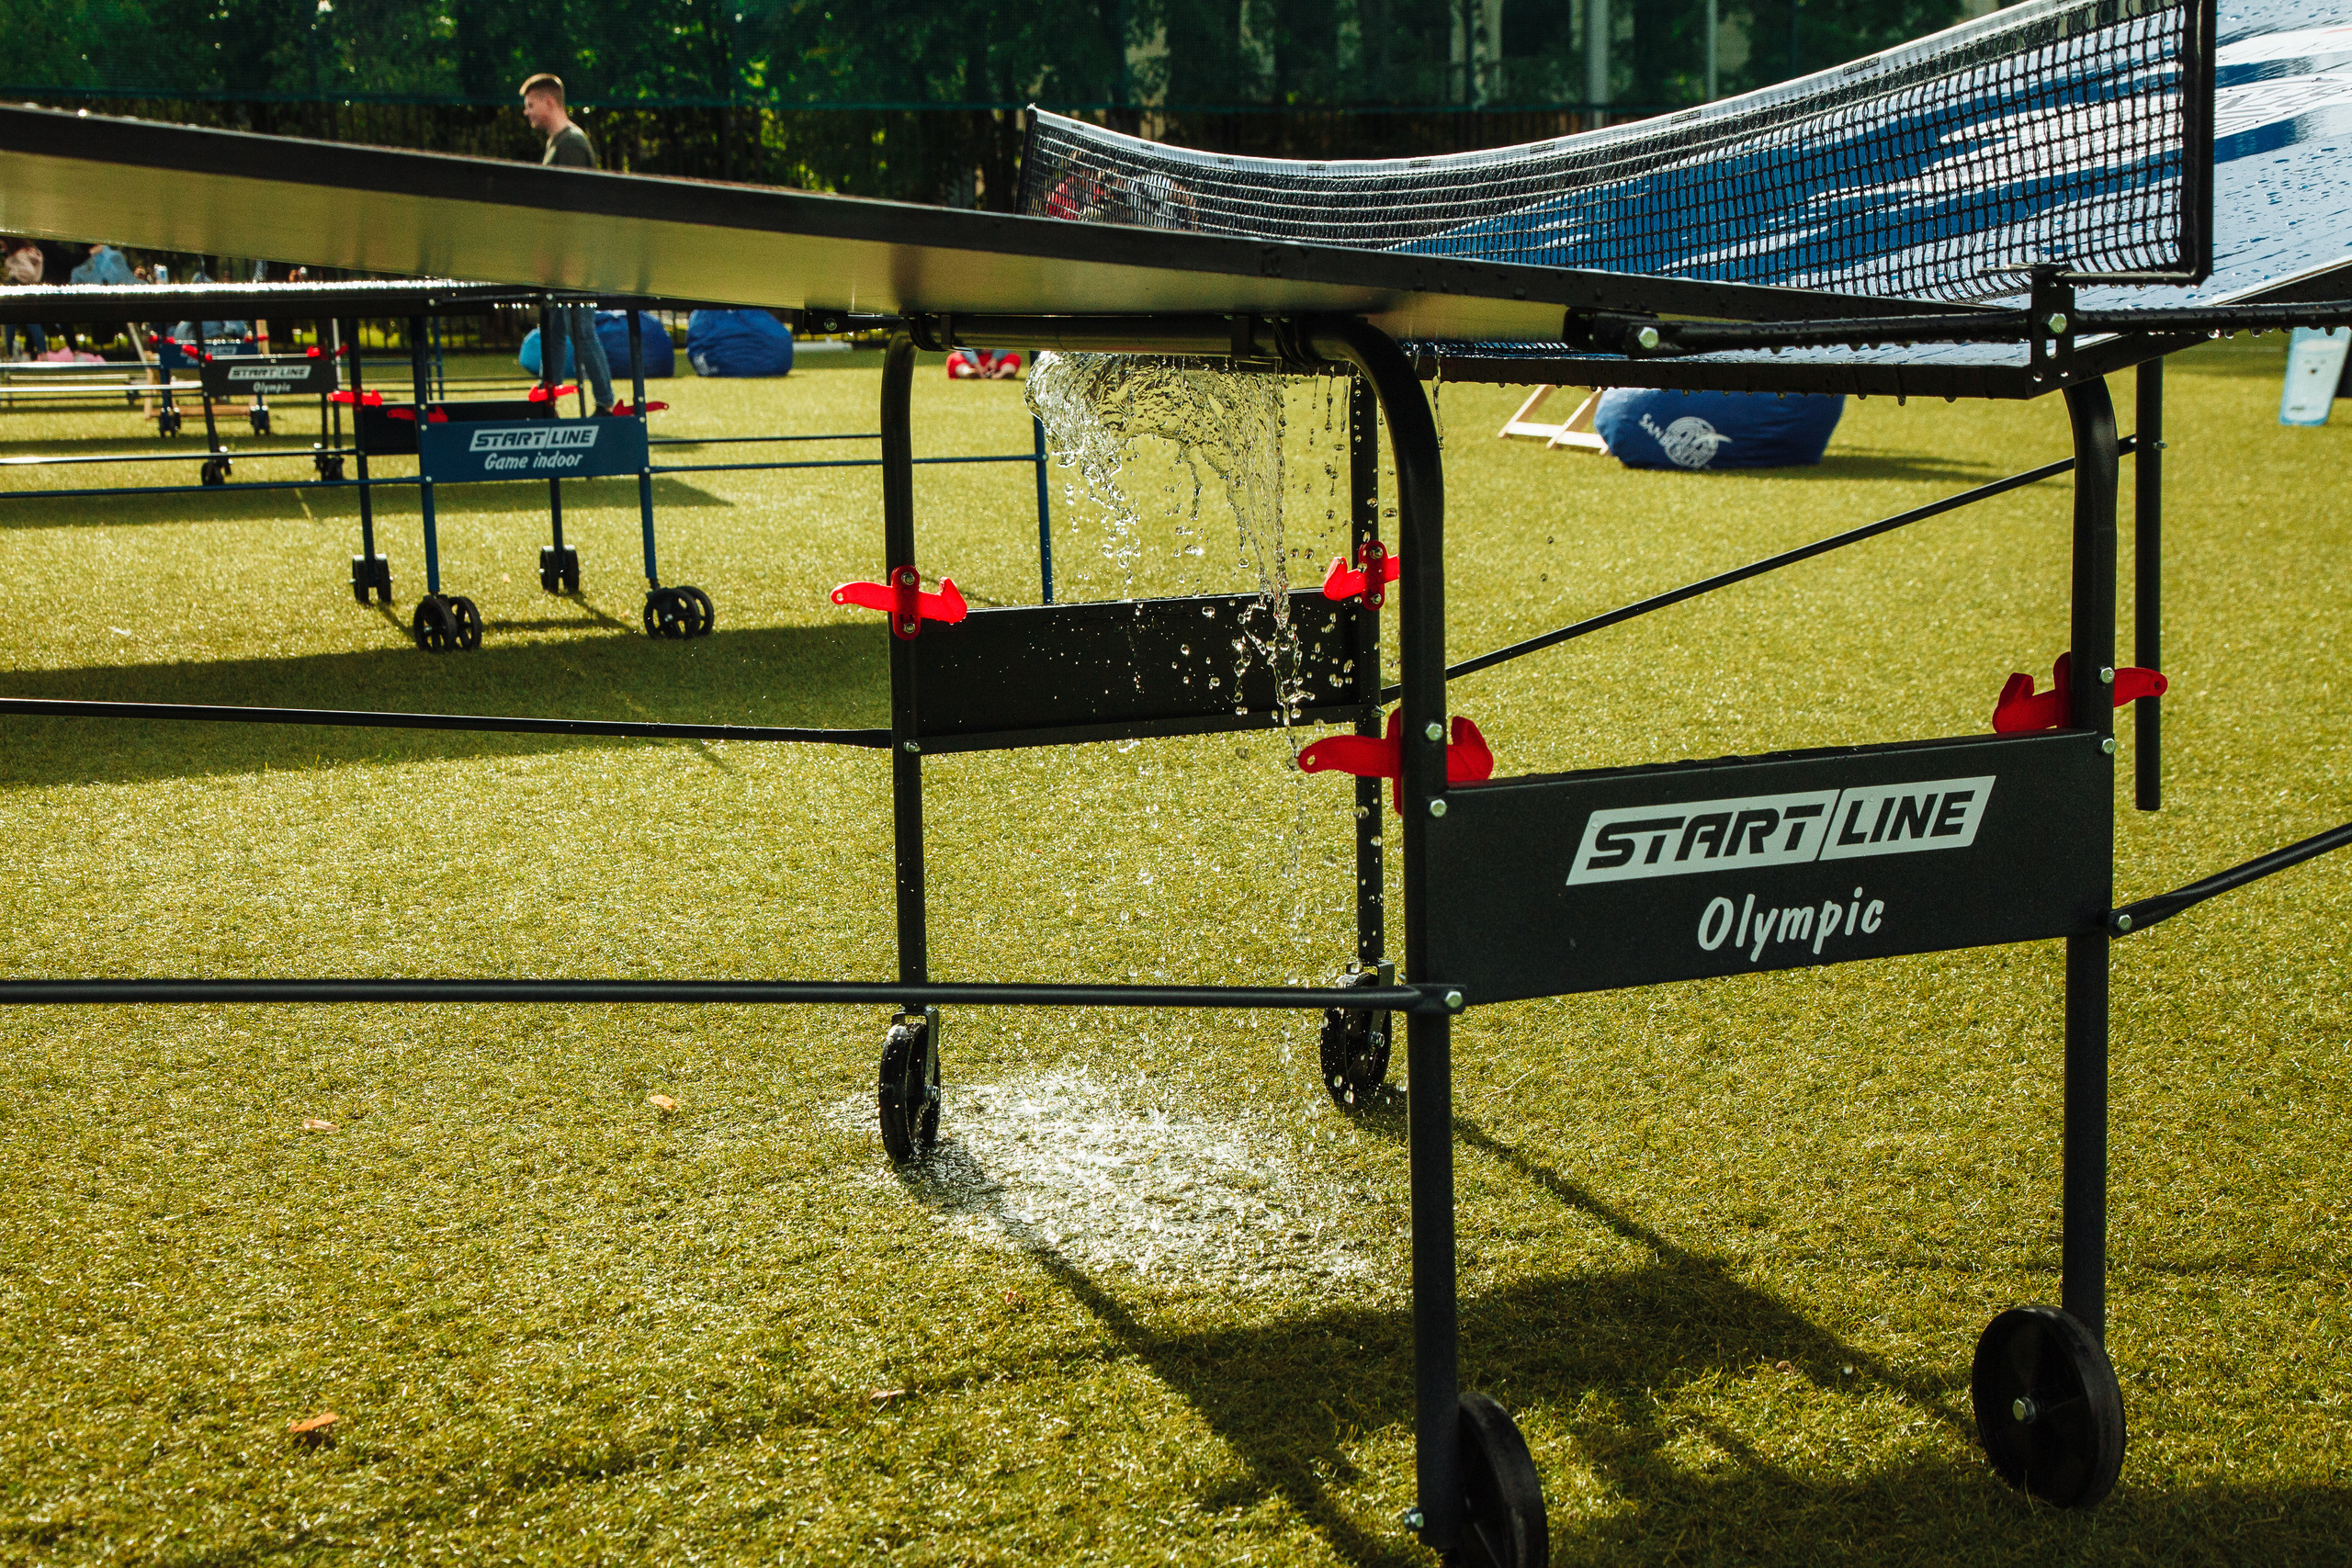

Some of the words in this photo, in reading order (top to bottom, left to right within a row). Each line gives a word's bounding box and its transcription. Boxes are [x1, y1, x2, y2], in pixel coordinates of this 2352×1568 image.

[253, 380, 291, 394] Olympic
[483, 452, 529, 471] Game
[532, 450, 583, 469] indoor
[1586, 802, 1826, 871] START
[1836, 789, 1976, 848] LINE
[1697, 886, 1885, 963] Olympic
